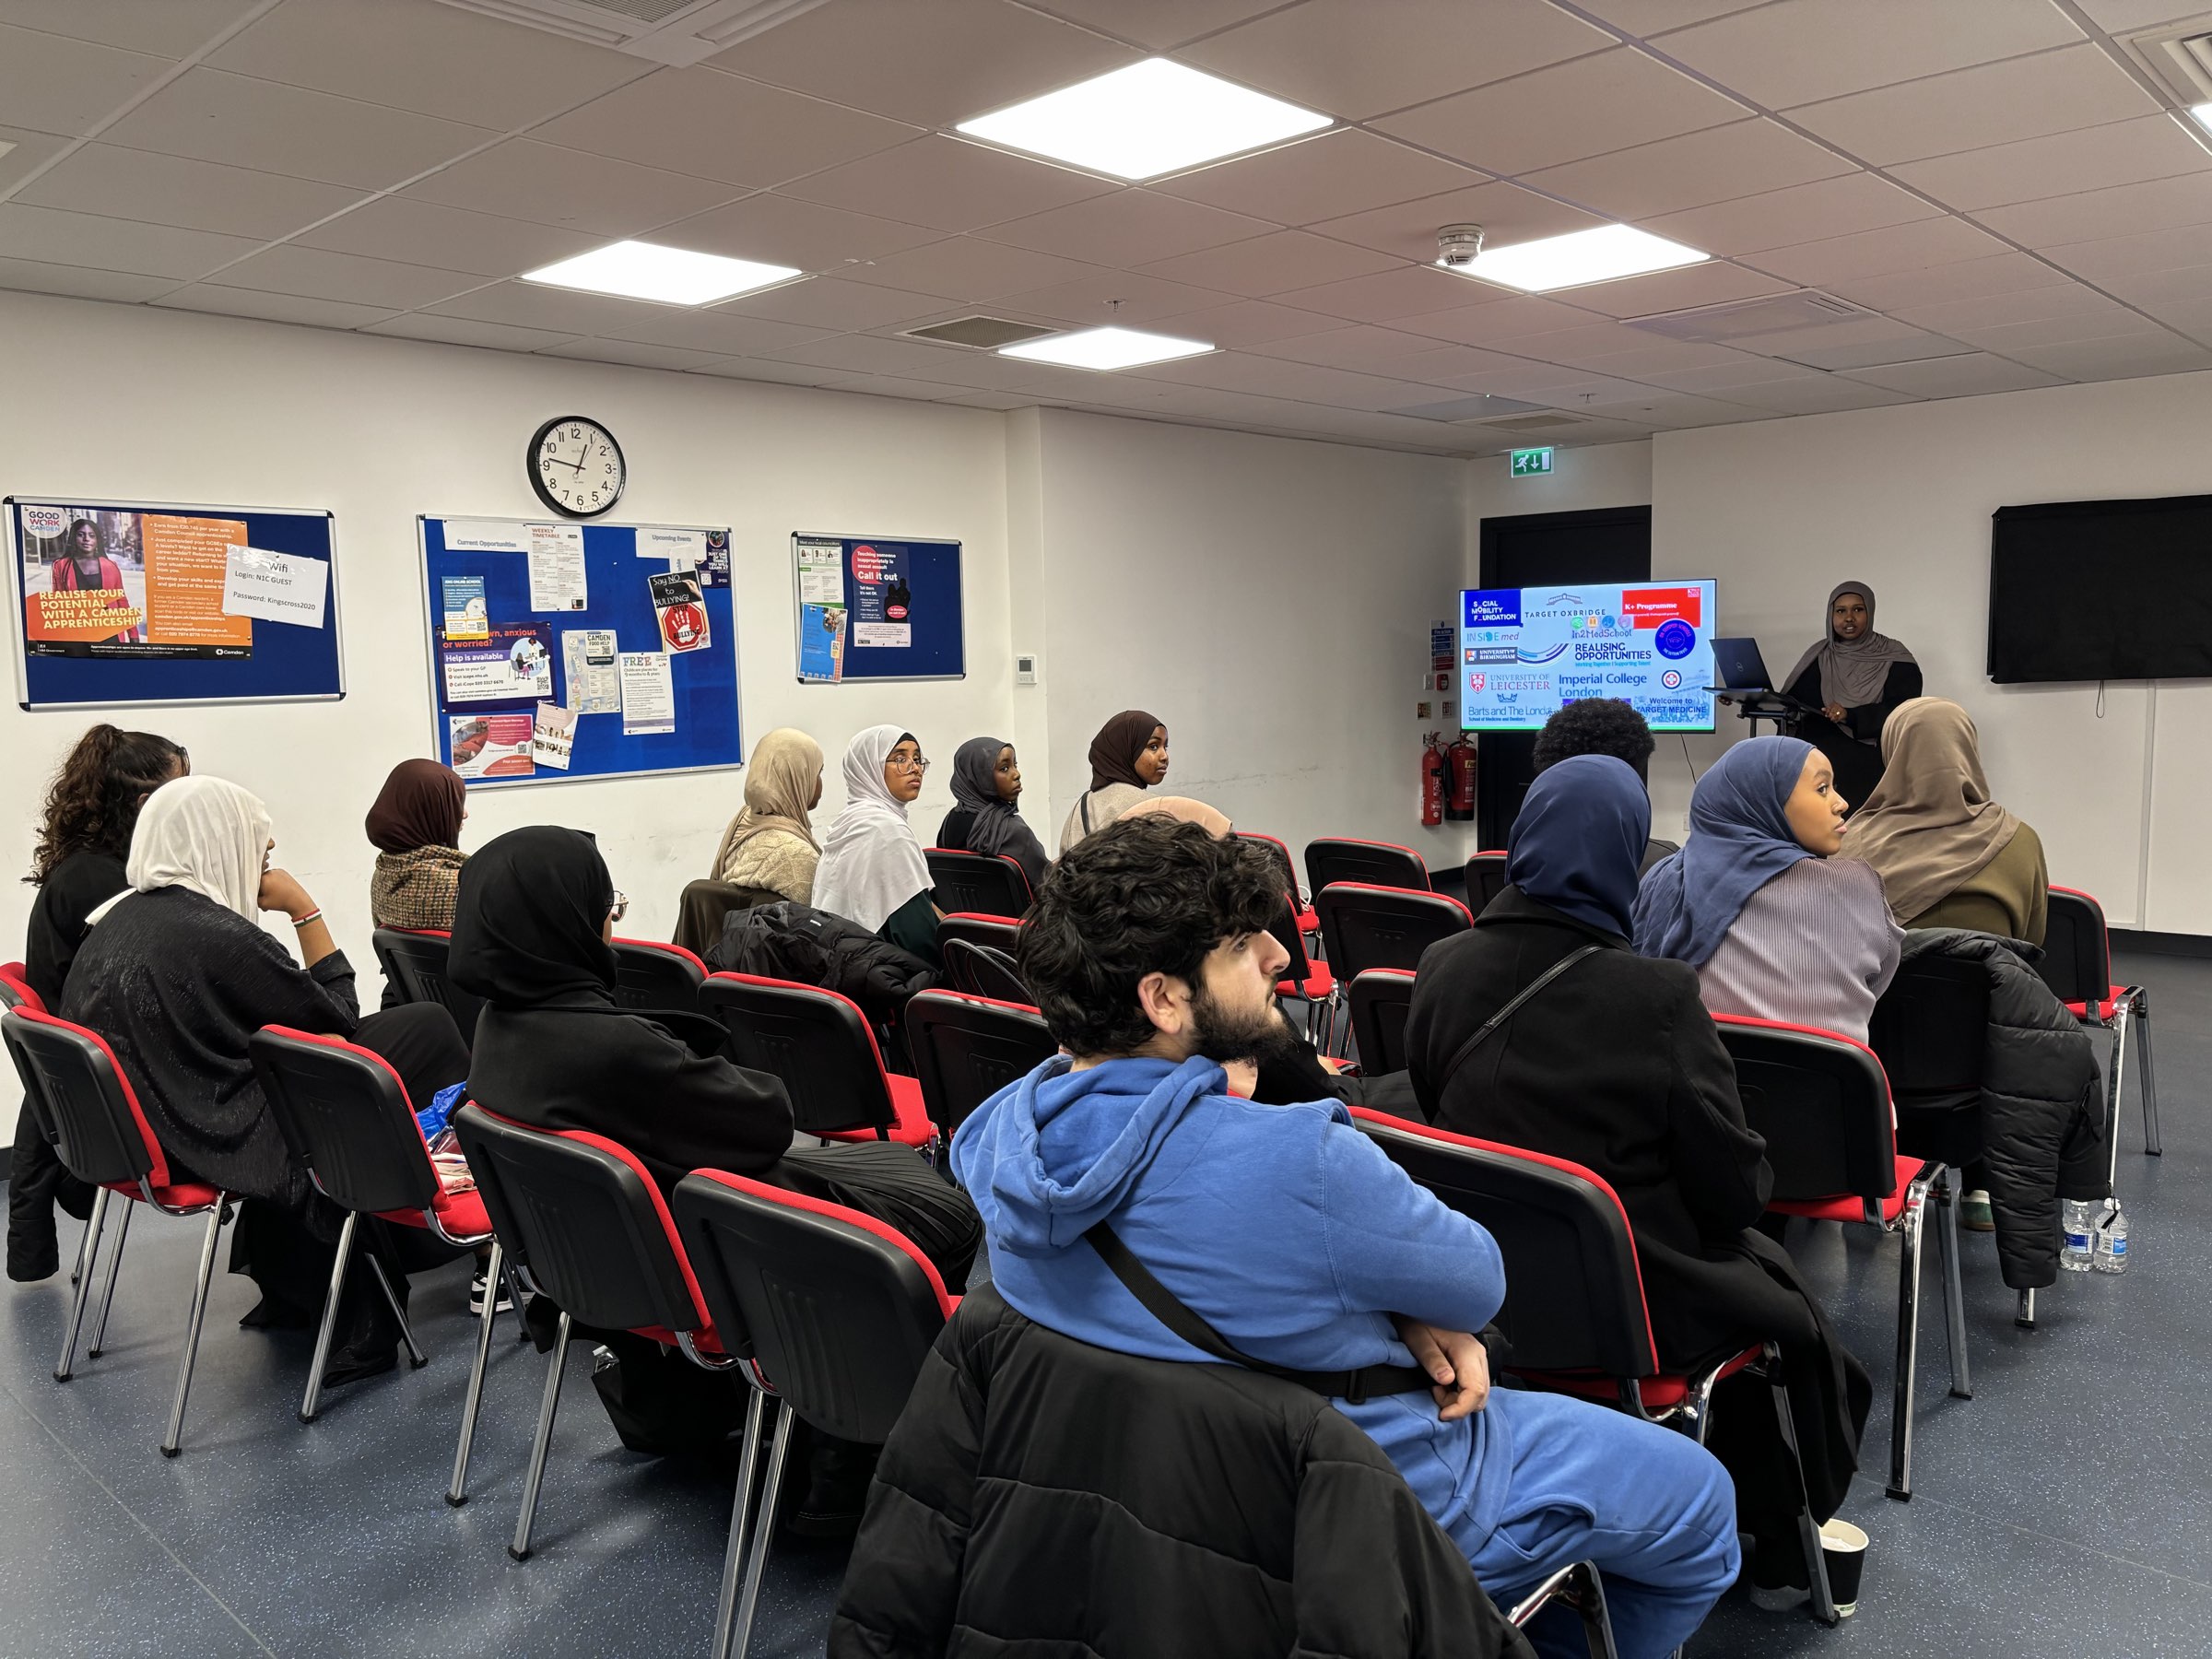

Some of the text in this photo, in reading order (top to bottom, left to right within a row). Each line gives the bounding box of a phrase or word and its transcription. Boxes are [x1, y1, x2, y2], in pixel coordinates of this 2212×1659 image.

[559, 432, 564, 442] 11
[571, 428, 581, 439] 12
[590, 434, 592, 444] 1
[547, 442, 556, 453] 10
[600, 446, 606, 456] 2
[543, 460, 550, 471] 9
[605, 464, 612, 474] 3
[550, 479, 557, 489] 8
[602, 481, 608, 491] 4
[563, 490, 569, 500] 7
[577, 495, 584, 505] 6
[592, 491, 598, 501] 5
[29, 511, 60, 519] GOOD
[269, 562, 288, 572] Wifi
[236, 571, 254, 579] Login:
[271, 577, 292, 585] GUEST
[653, 577, 667, 586] Say
[39, 589, 124, 600] REALISE YOUR
[40, 599, 106, 609] POTENTIAL
[233, 591, 316, 610] Password: Kingscross2020
[655, 595, 689, 606] BULLYING!
[41, 610, 74, 619] WITH
[92, 608, 142, 617] CAMDEN
[44, 616, 143, 629] APPRENTICESHIP
[673, 629, 699, 639] BULLYING
[1572, 629, 1632, 639] In2MedSchool
[455, 639, 493, 648] worried?
[1575, 642, 1625, 651] REALISING
[1575, 651, 1651, 660] OPPORTUNITIES
[623, 657, 652, 667] FREE
[1559, 673, 1647, 686] Imperial College
[1491, 682, 1550, 690] LEICESTER
[1559, 687, 1602, 697] London
[1469, 706, 1489, 715] Barts
[1491, 706, 1506, 715] and
[1509, 706, 1524, 715] The
